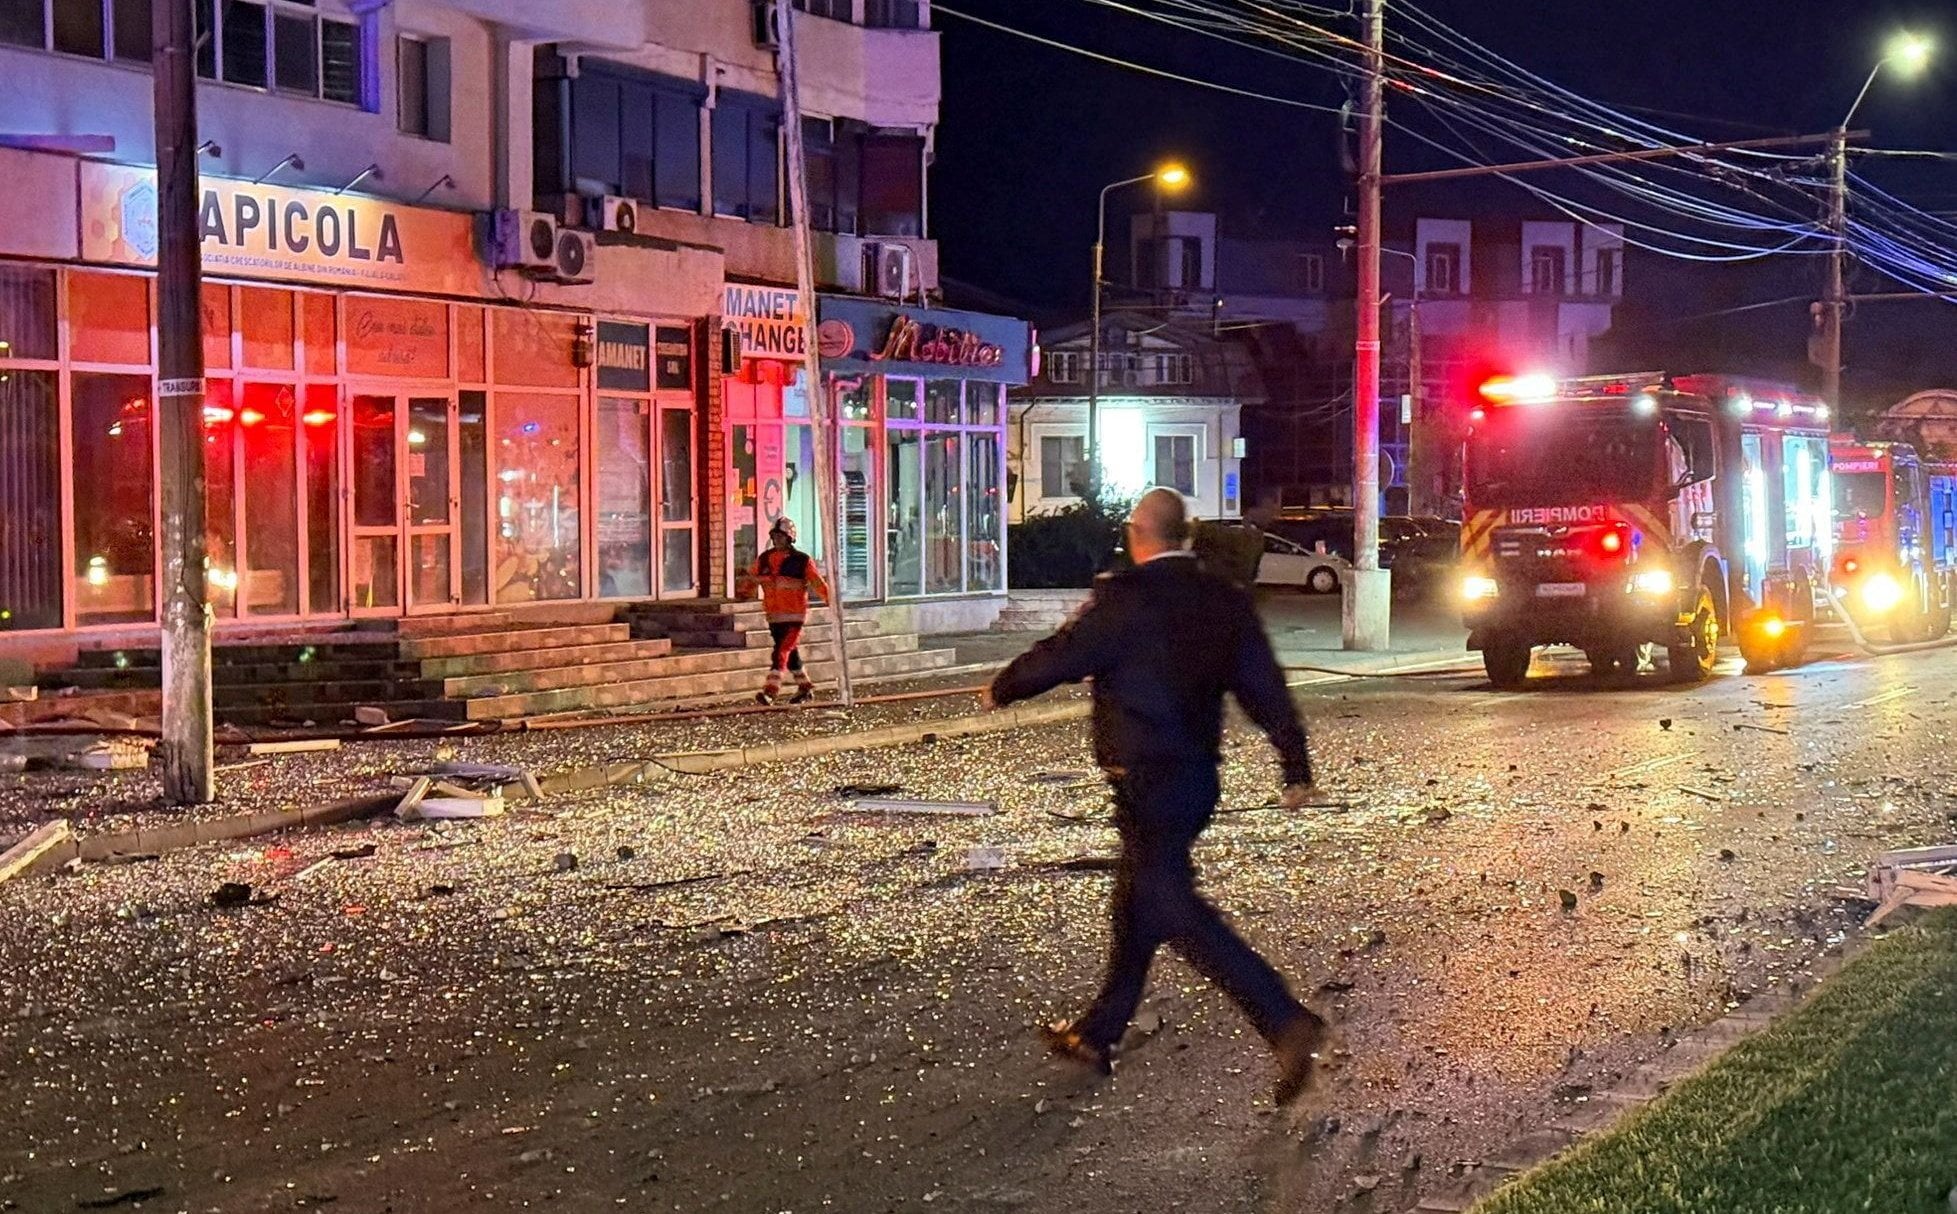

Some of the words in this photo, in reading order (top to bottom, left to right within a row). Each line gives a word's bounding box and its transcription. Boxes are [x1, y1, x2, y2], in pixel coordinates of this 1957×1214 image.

[200, 189, 404, 264] APICOLA
[726, 286, 798, 321] MANET
[741, 321, 805, 354] HANGE
[598, 341, 646, 370] AMANET
